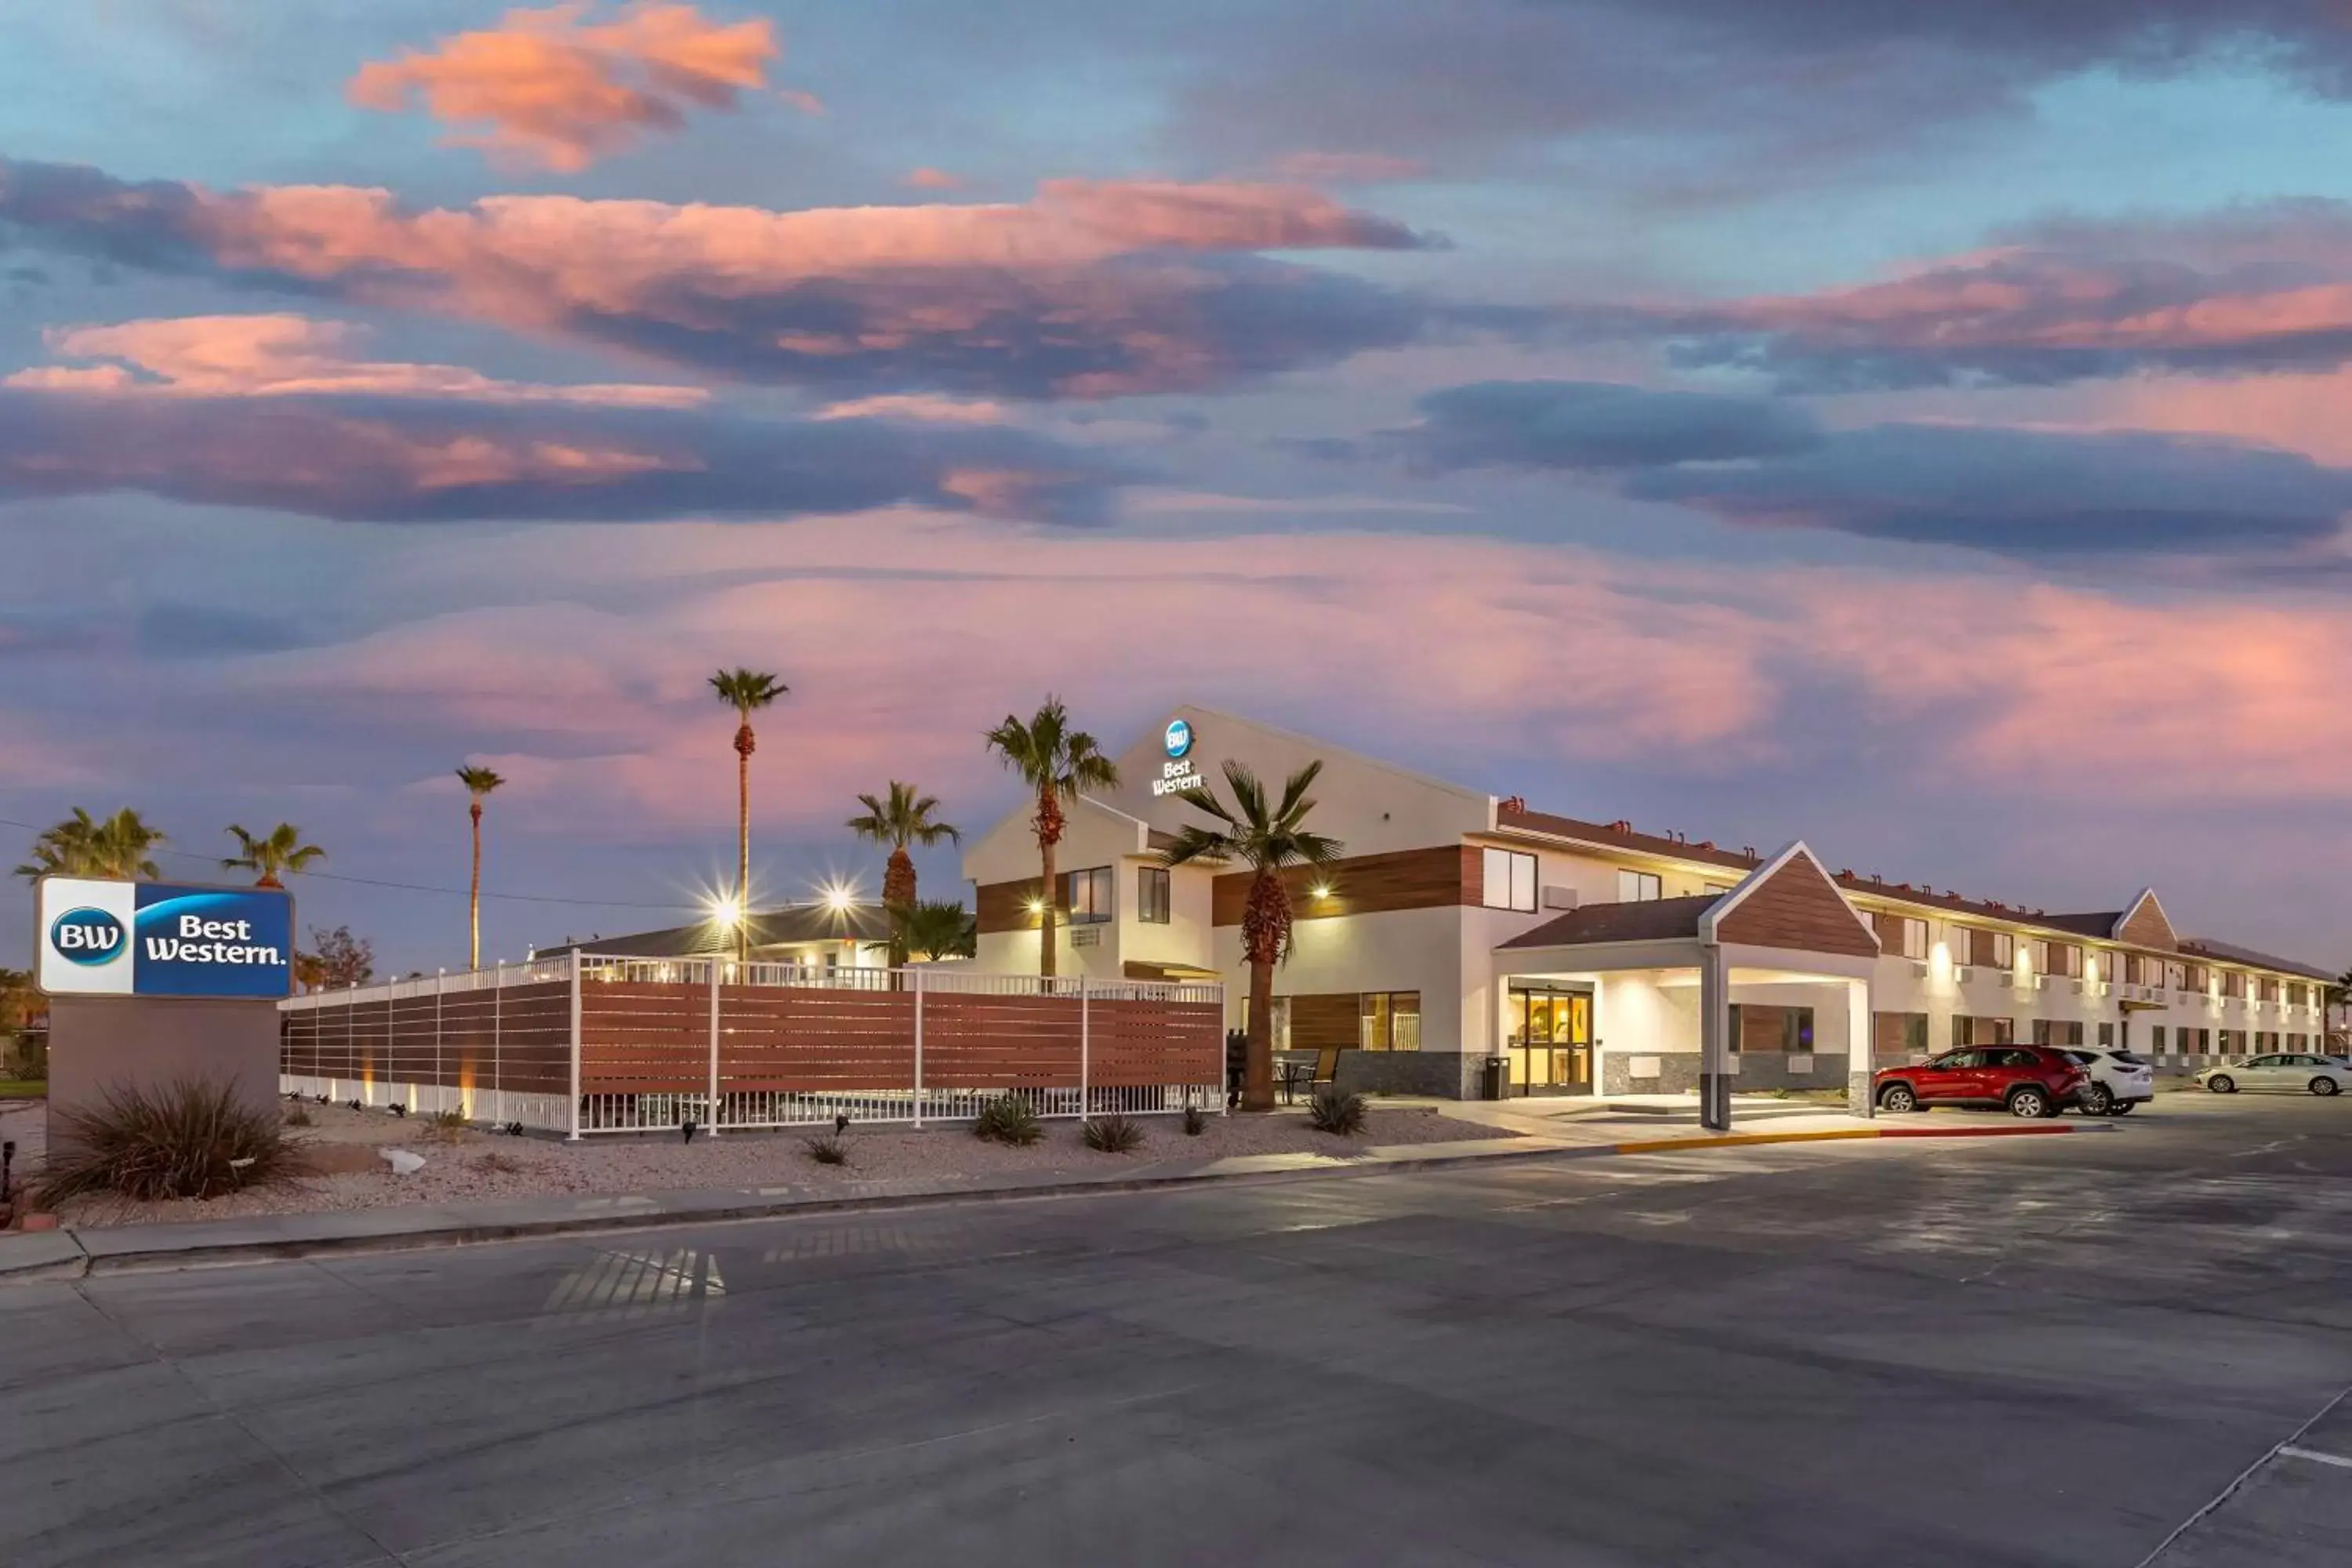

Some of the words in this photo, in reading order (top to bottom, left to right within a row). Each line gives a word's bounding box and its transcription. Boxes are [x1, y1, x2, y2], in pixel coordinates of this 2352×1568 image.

[1167, 729, 1187, 749] BW
[1164, 760, 1190, 778] Best
[60, 924, 118, 950] BW
[180, 915, 251, 940] Best
[146, 937, 286, 965] Western.
